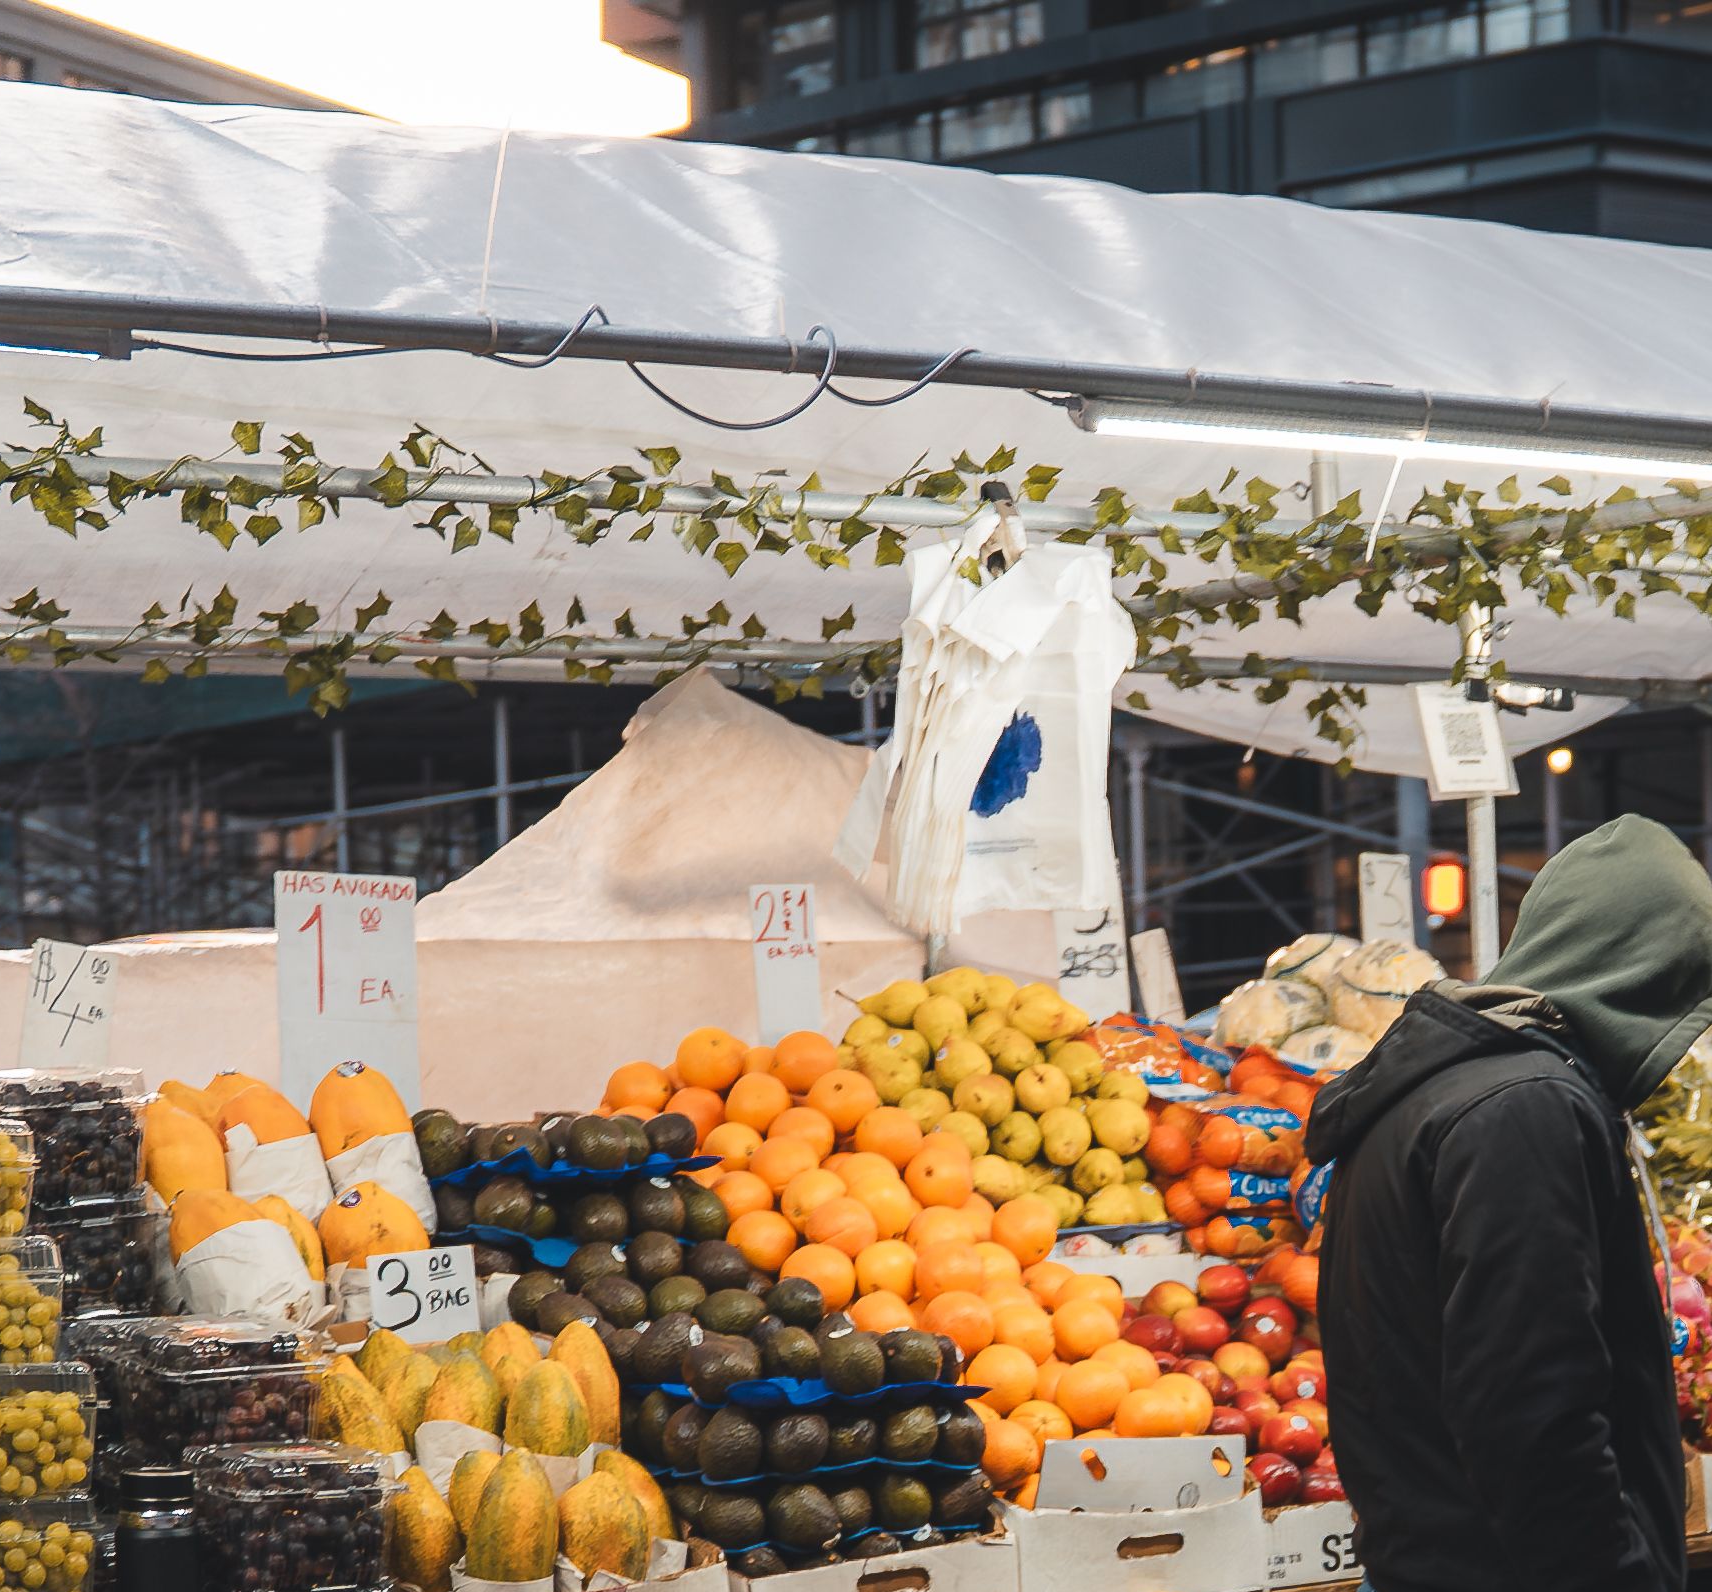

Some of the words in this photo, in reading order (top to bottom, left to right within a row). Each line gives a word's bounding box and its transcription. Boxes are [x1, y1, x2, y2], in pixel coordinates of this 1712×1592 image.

[282, 873, 325, 895] HAS
[333, 877, 414, 901] AVOKADO
[754, 891, 788, 943] 2
[797, 889, 808, 939] 1
[298, 903, 324, 1015] 1
[48, 949, 94, 1048] 4
[375, 1258, 422, 1331] 3
[429, 1253, 454, 1280] 00
[426, 1288, 469, 1313] BAG
